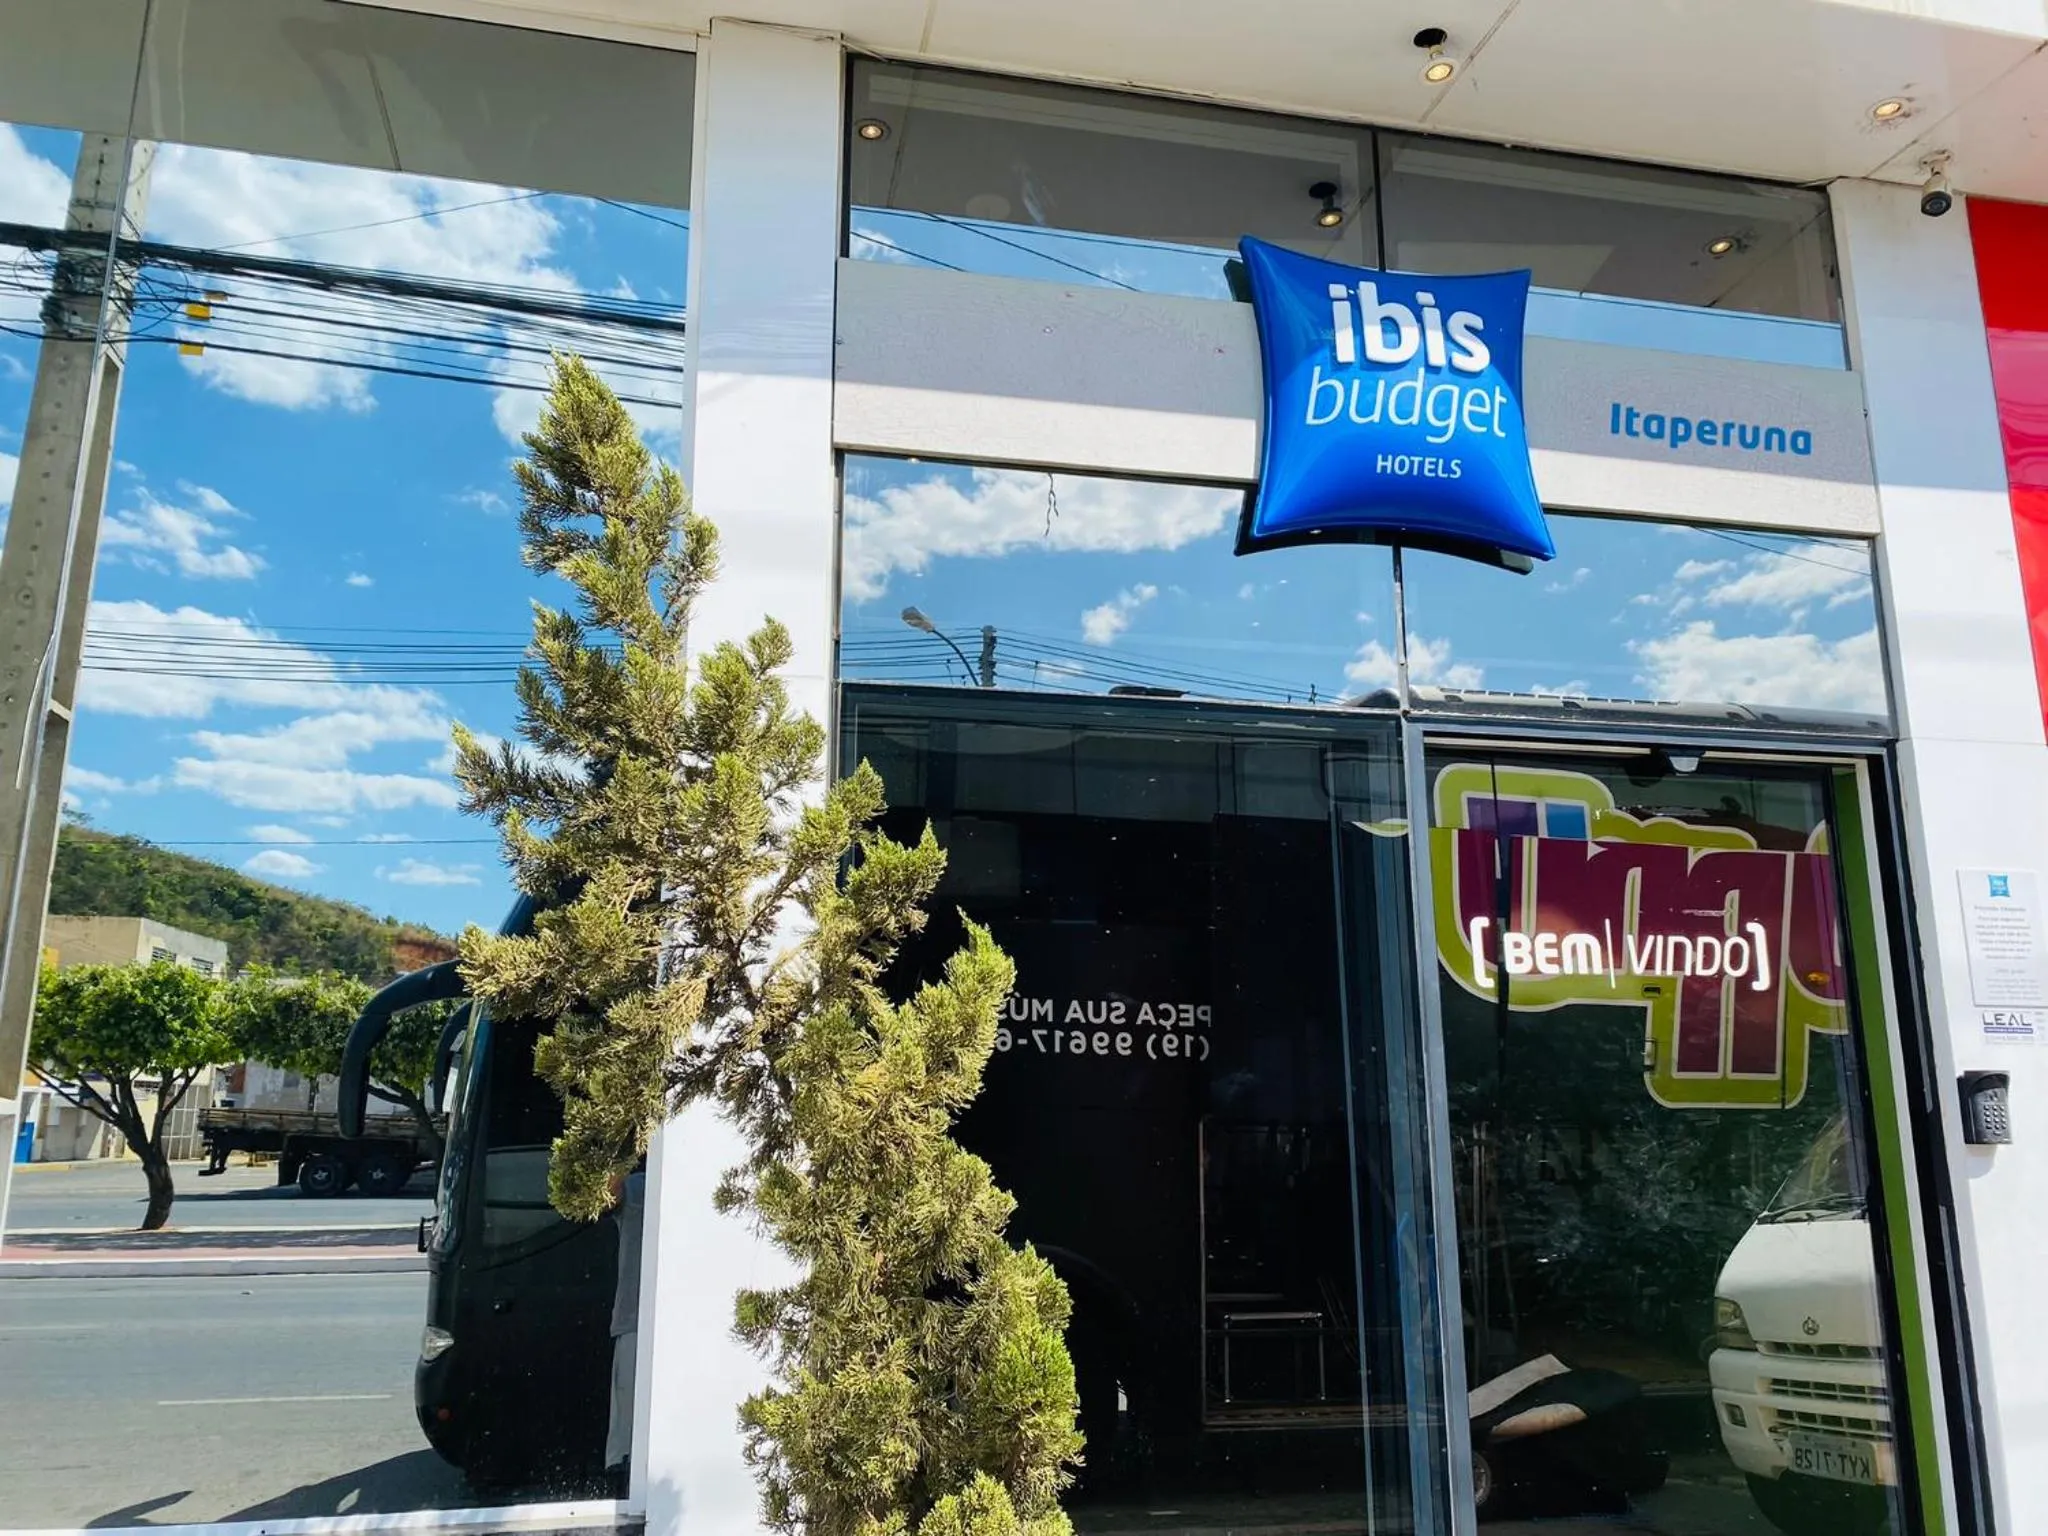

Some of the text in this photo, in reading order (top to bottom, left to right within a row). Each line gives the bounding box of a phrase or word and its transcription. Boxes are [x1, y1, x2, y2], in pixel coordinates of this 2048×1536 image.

[1328, 280, 1491, 373] ibis
[1305, 366, 1507, 443] budget
[1610, 403, 1812, 456] Itaperuna
[1376, 454, 1462, 479] HOTELS
[1982, 1013, 2032, 1026] LEAL
